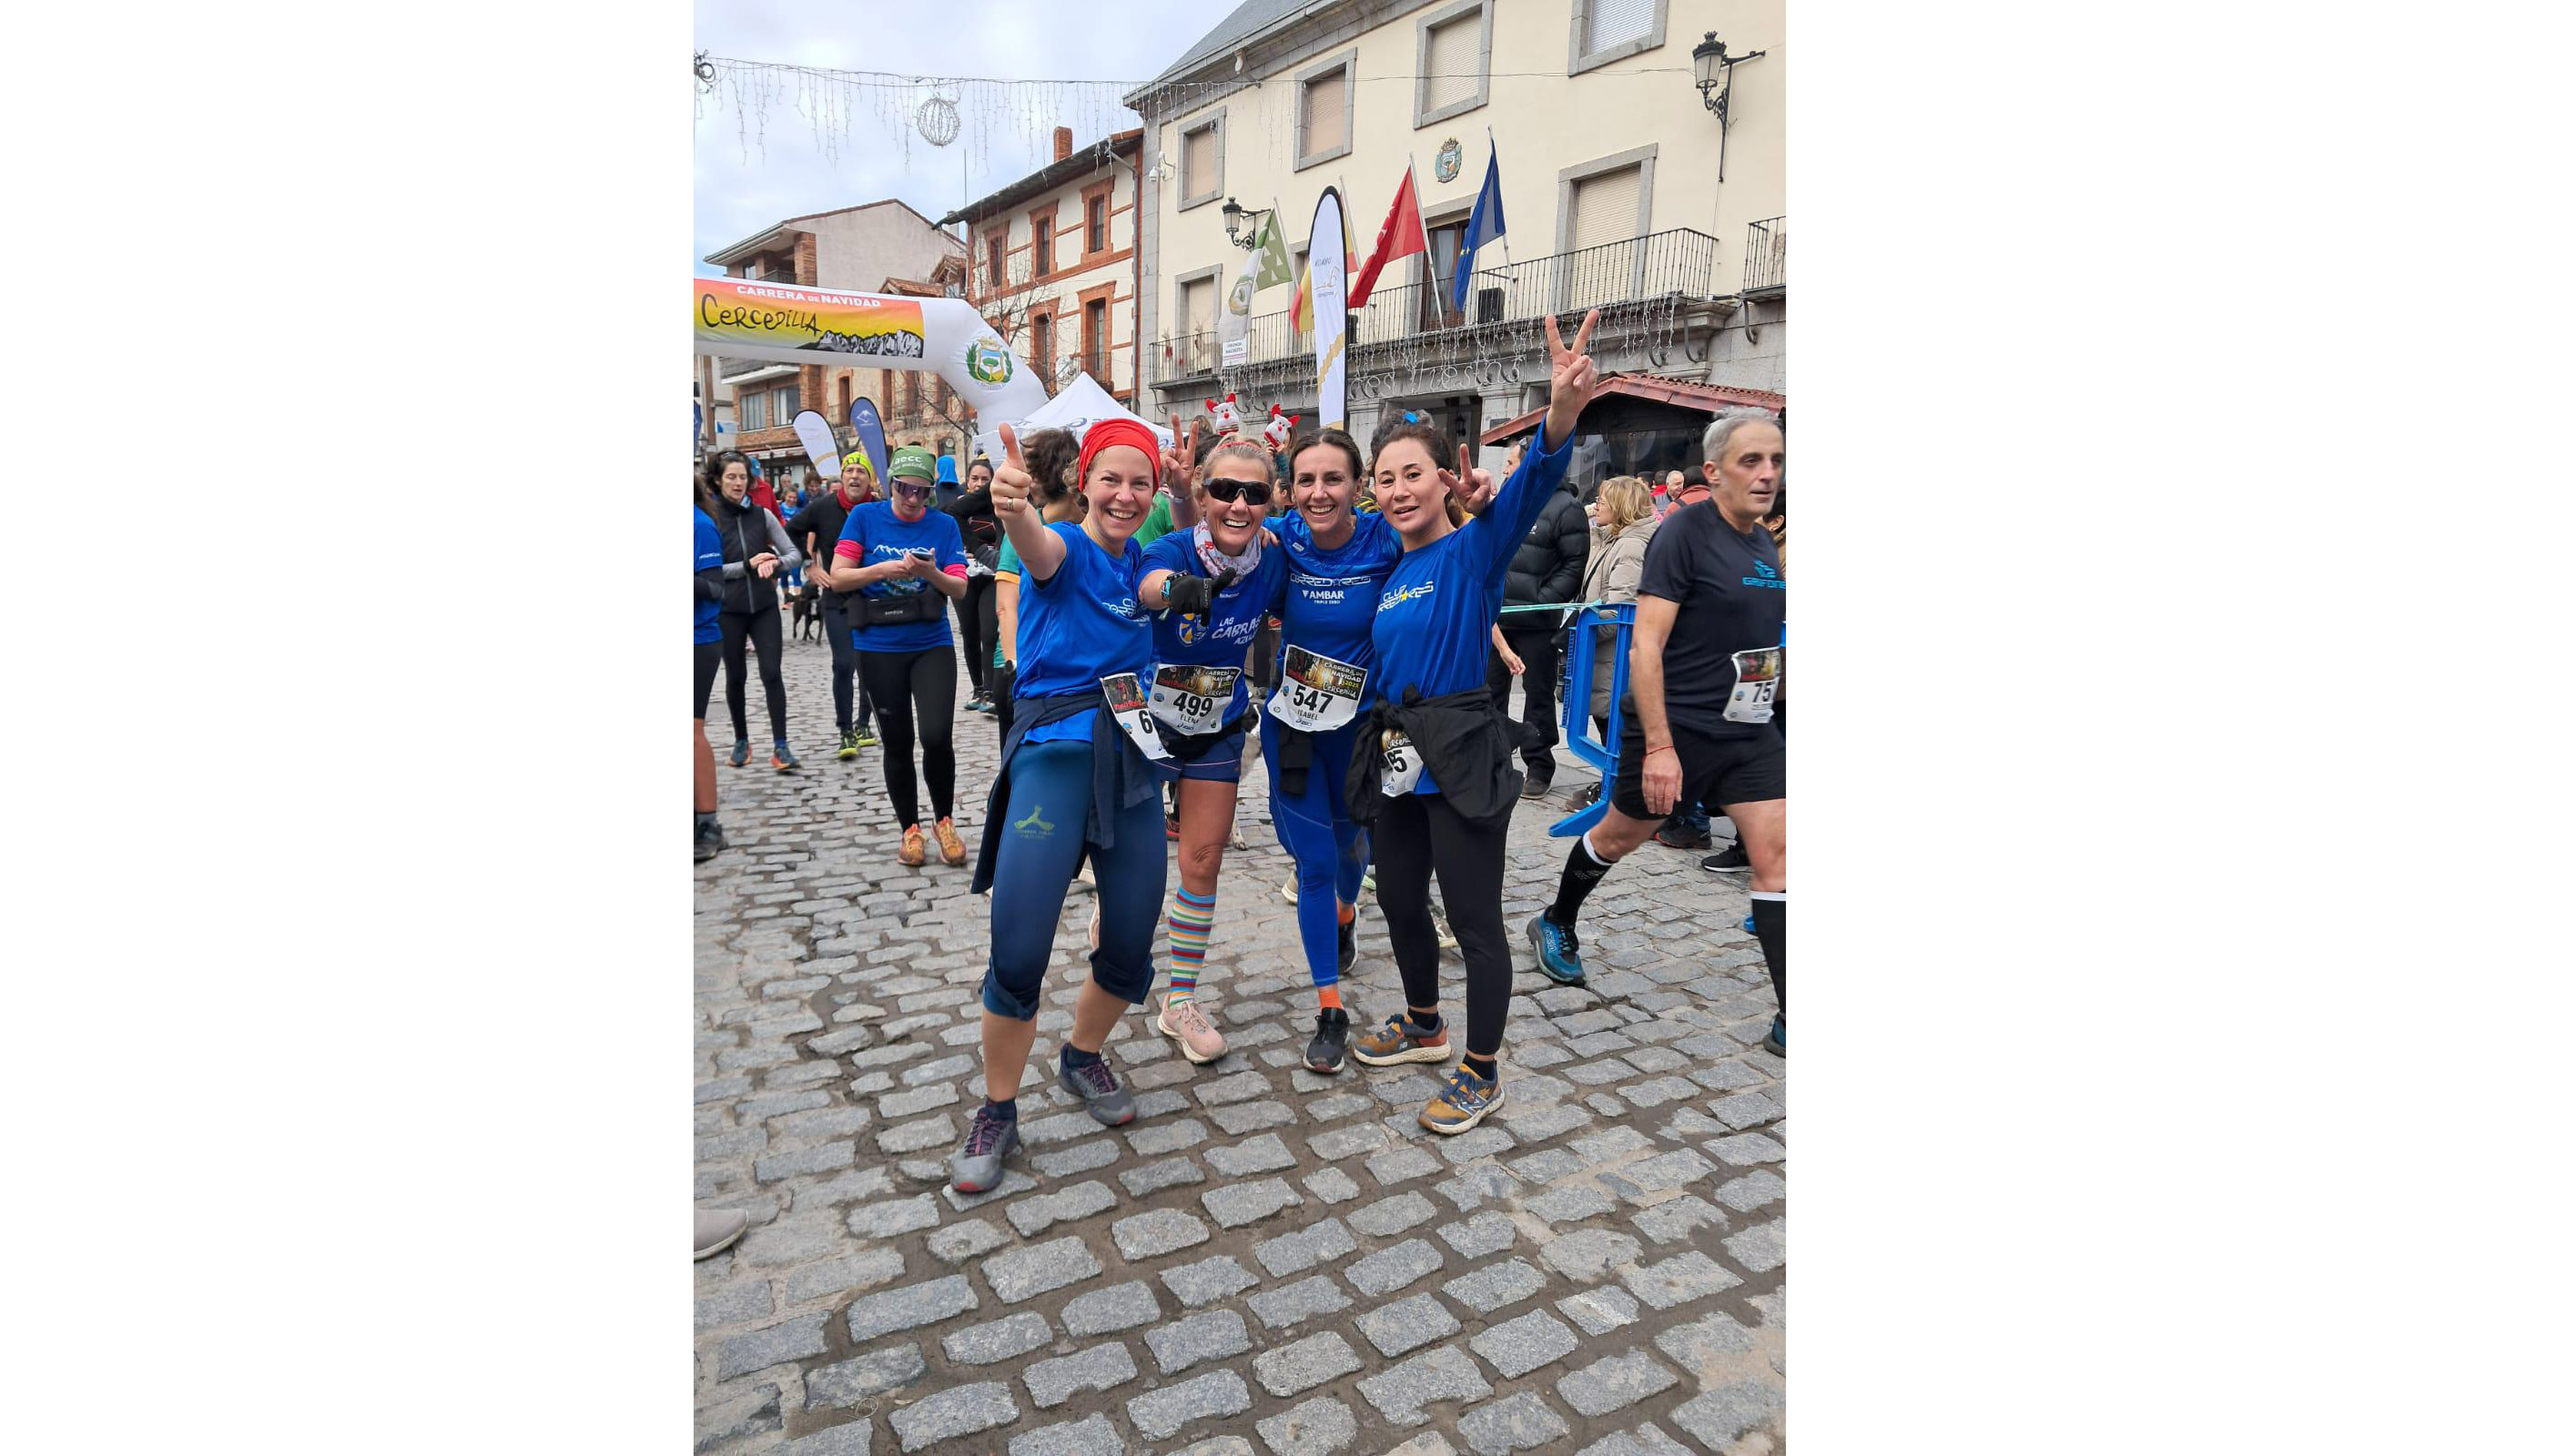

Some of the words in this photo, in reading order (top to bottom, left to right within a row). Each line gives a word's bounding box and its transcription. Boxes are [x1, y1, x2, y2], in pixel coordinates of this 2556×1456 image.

[736, 286, 805, 300] CARRERA
[807, 295, 820, 303] DE
[820, 293, 881, 308] NAVIDAD
[895, 456, 923, 465] aecc
[1309, 590, 1345, 600] AMBAR
[1212, 613, 1263, 640] CABRAS
[1219, 616, 1235, 627] LAS
[1324, 662, 1355, 675] CARRERA
[1332, 671, 1363, 682] NAVIDAD
[1173, 693, 1213, 717] 499
[1293, 684, 1334, 713] 547
[1297, 710, 1319, 721] ISABEL
[1387, 749, 1407, 773] 5
